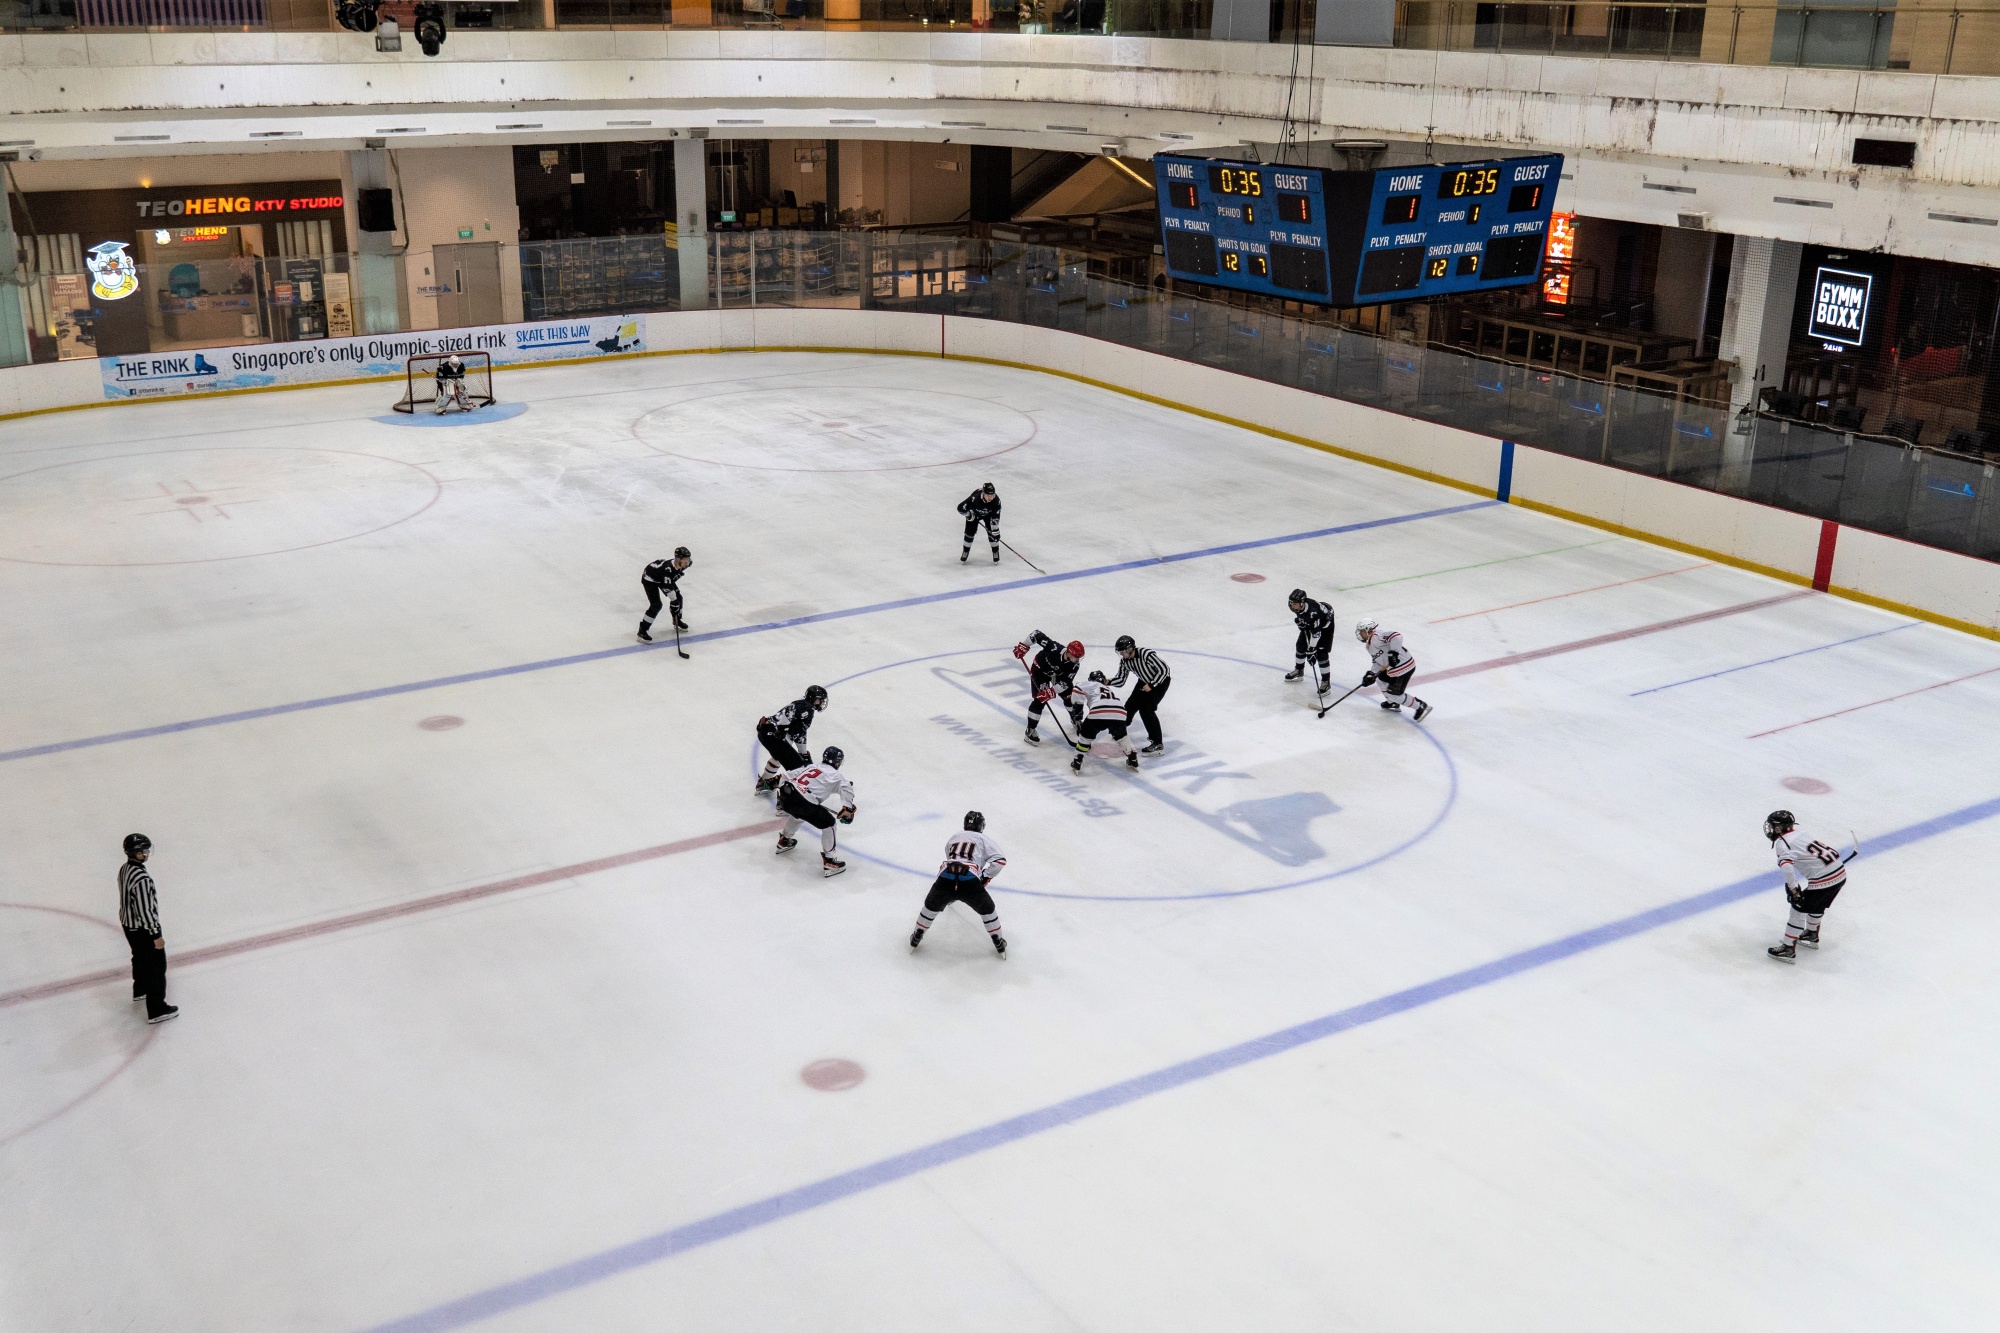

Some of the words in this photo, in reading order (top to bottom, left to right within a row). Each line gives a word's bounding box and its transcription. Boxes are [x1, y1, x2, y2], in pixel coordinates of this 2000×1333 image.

[1167, 163, 1194, 179] HOME
[1513, 164, 1550, 182] GUEST
[1221, 169, 1261, 196] 0:35
[1274, 173, 1308, 191] GUEST
[1389, 174, 1424, 192] HOME
[1453, 169, 1498, 196] 0:35
[254, 199, 286, 212] KTV
[289, 196, 344, 210] STUDIO
[1189, 186, 1195, 206] 1
[1531, 187, 1539, 207] 1
[1217, 206, 1241, 218] PERIOD
[1248, 207, 1253, 222] 1
[1301, 199, 1307, 220] 1
[1409, 198, 1416, 219] 1
[1438, 210, 1465, 223] PERIOD
[1473, 206, 1479, 221] 1
[1164, 217, 1180, 229] PLYR
[1184, 219, 1210, 232] PENALTY
[1491, 224, 1509, 236] PLYR
[1513, 220, 1544, 234] PENALTY
[1217, 238, 1239, 250] SHOTS
[1239, 240, 1250, 252] ON
[1250, 242, 1268, 254] GOAL
[1270, 230, 1287, 242] PLYR
[1291, 233, 1321, 247] PENALTY
[1370, 235, 1390, 248] PLYR
[1394, 232, 1428, 246] PENALTY
[1428, 243, 1452, 257] SHOTS
[1453, 242, 1464, 254] ON
[1465, 241, 1483, 253] GOAL
[1226, 254, 1238, 271] 12
[1258, 257, 1266, 274] 7
[1432, 259, 1447, 277] 12
[1471, 256, 1478, 272] 7
[1819, 282, 1863, 309] GYMM
[1816, 302, 1860, 331] BOXX.
[516, 328, 545, 343] SKATE
[547, 326, 568, 340] THIS
[570, 324, 591, 338] WAY
[232, 345, 325, 372] Singapore's
[329, 343, 364, 364] only
[368, 333, 472, 361] Olympic-sized
[477, 330, 507, 350] rink
[115, 361, 148, 378] THE
[152, 357, 191, 375] RINK
[928, 714, 1125, 818] www.therink.sg
